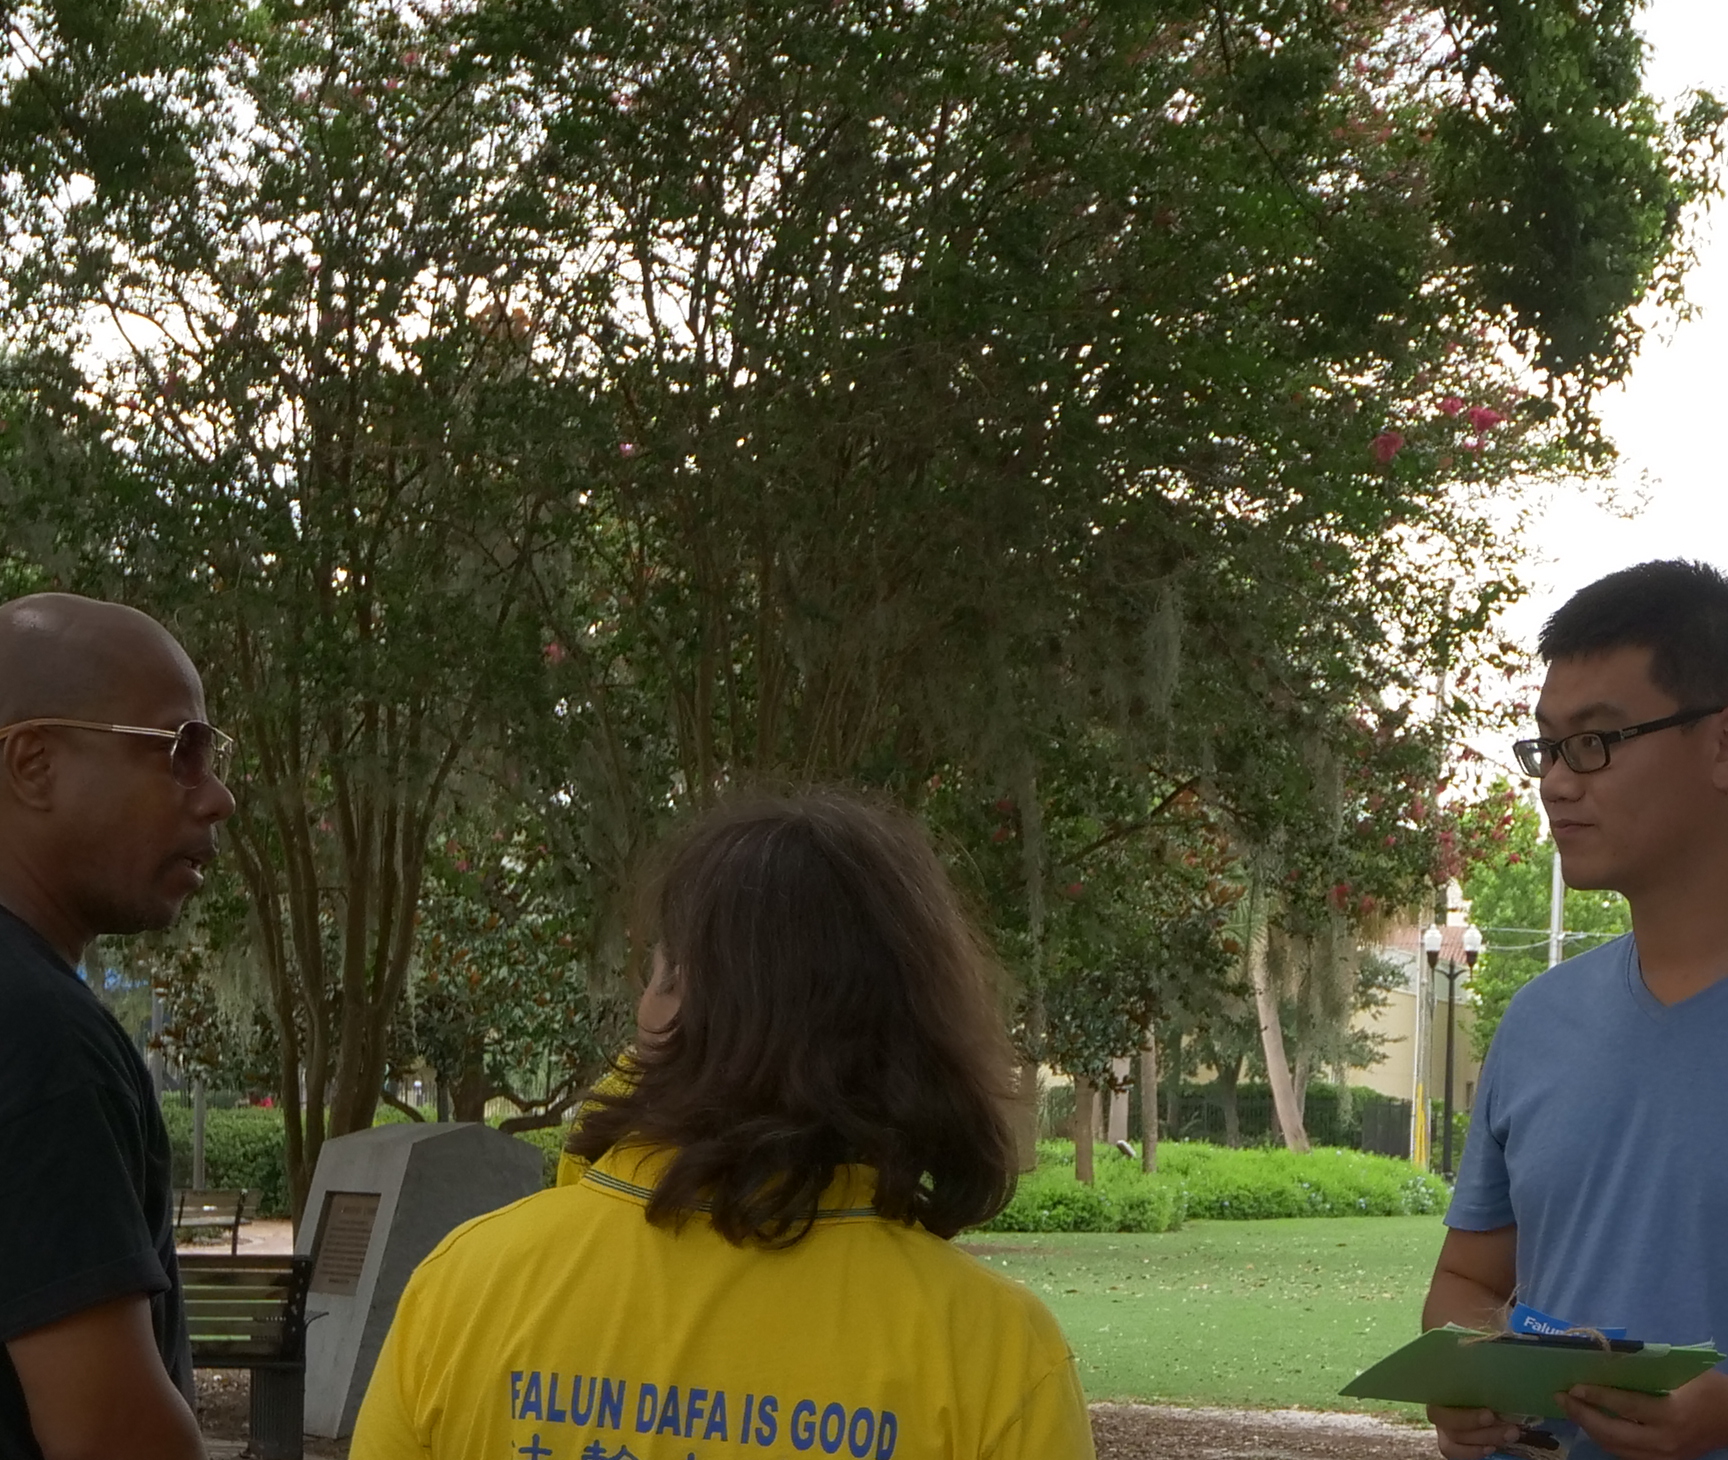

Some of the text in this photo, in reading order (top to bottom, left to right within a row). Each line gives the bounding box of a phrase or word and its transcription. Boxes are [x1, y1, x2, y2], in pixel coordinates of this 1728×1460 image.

[511, 1369, 627, 1431] FALUN
[636, 1383, 728, 1442] DAFA
[741, 1393, 779, 1446] IS
